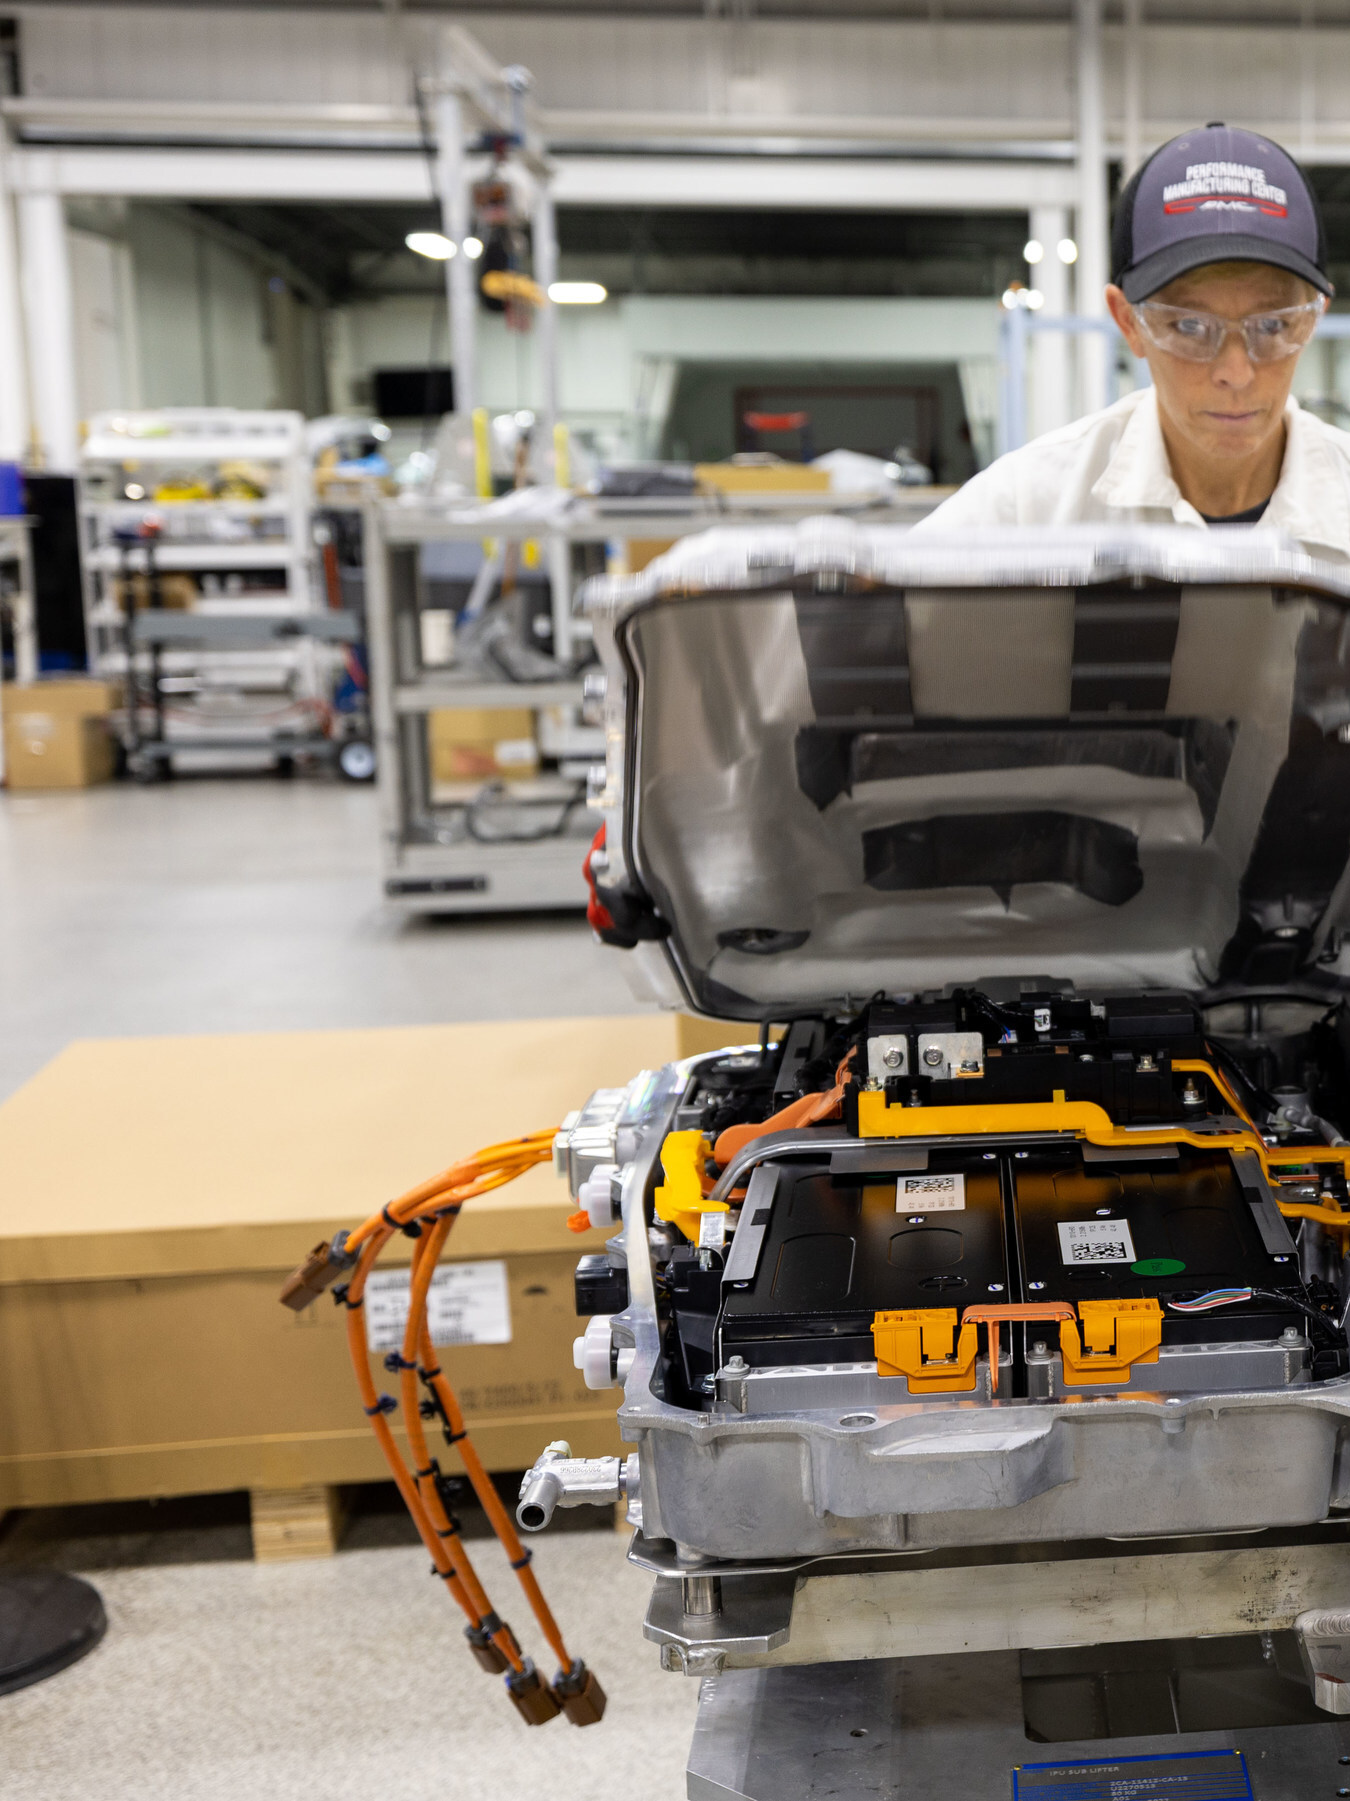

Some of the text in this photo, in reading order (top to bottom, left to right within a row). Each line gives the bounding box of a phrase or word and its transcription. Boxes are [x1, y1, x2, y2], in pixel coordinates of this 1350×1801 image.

[1186, 161, 1267, 185] PERFORMANCE
[1163, 177, 1288, 207] MANUFACTURING CENTER
